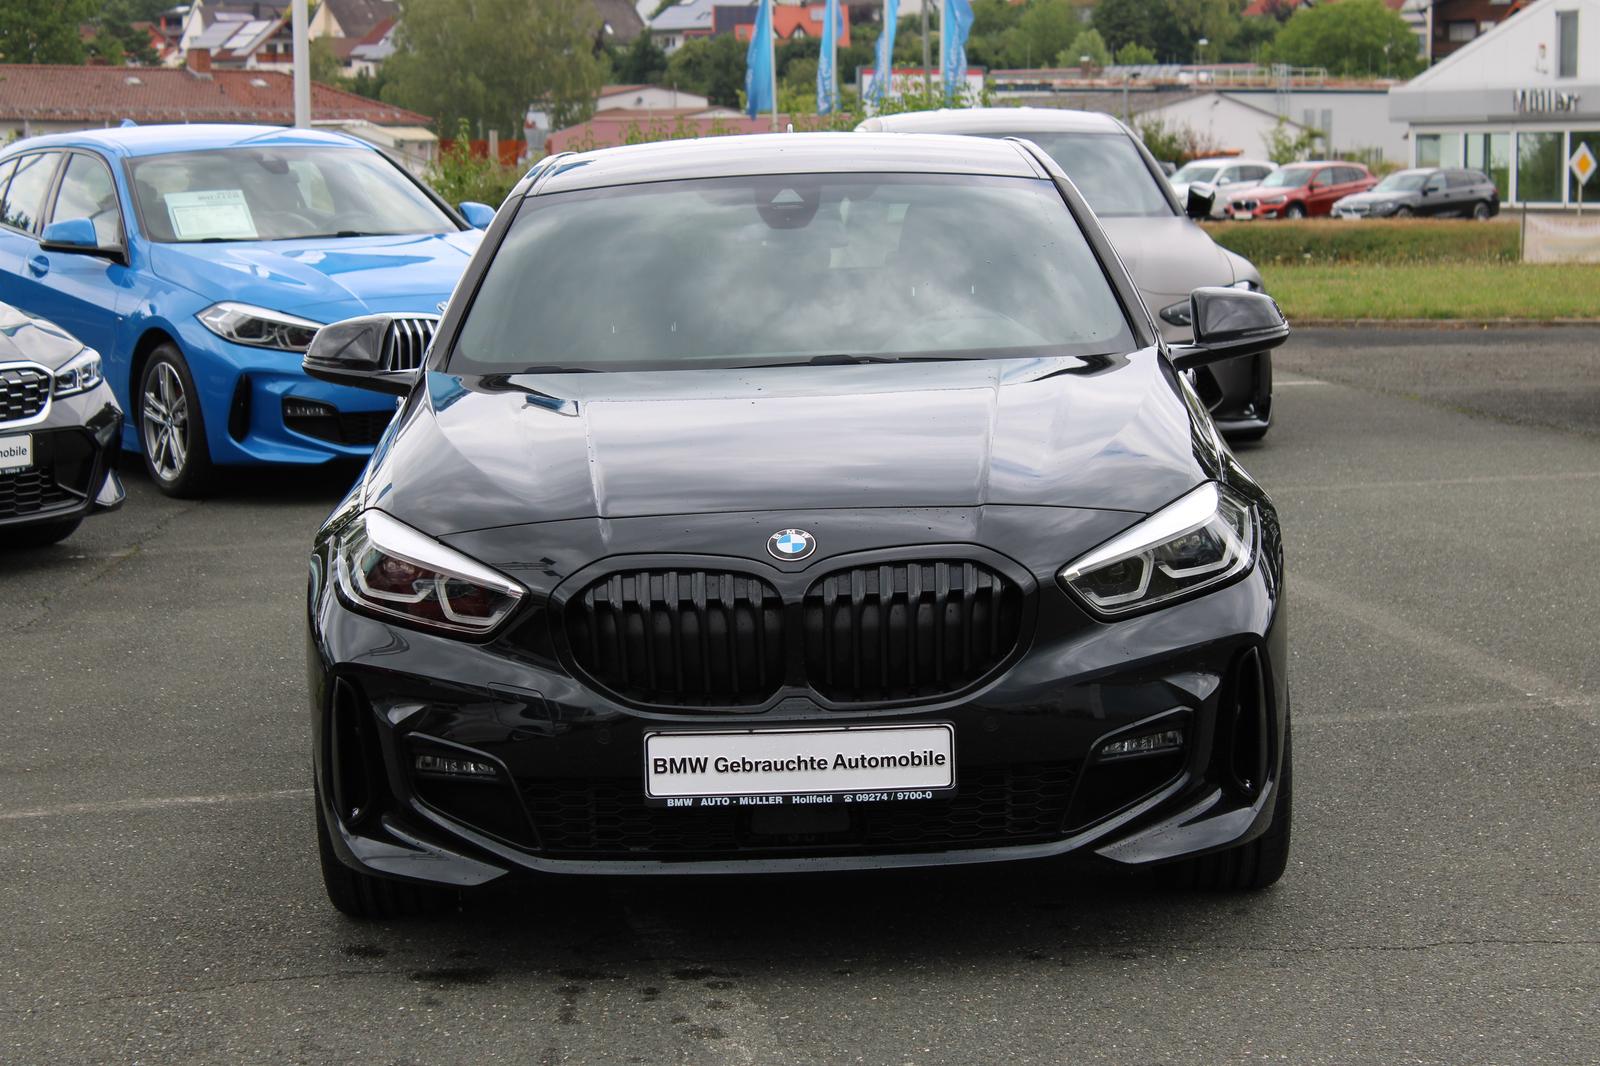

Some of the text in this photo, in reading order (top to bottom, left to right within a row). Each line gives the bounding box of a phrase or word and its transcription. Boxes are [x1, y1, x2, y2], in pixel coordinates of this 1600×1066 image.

[653, 750, 946, 774] BMW Gebrauchte Automobile
[667, 798, 693, 807] BMW
[700, 797, 730, 806] AUTO
[739, 795, 783, 805] MÜLLER
[792, 794, 833, 804] Hollfeld
[856, 792, 888, 802] 09274
[897, 790, 932, 800] 9700-0
